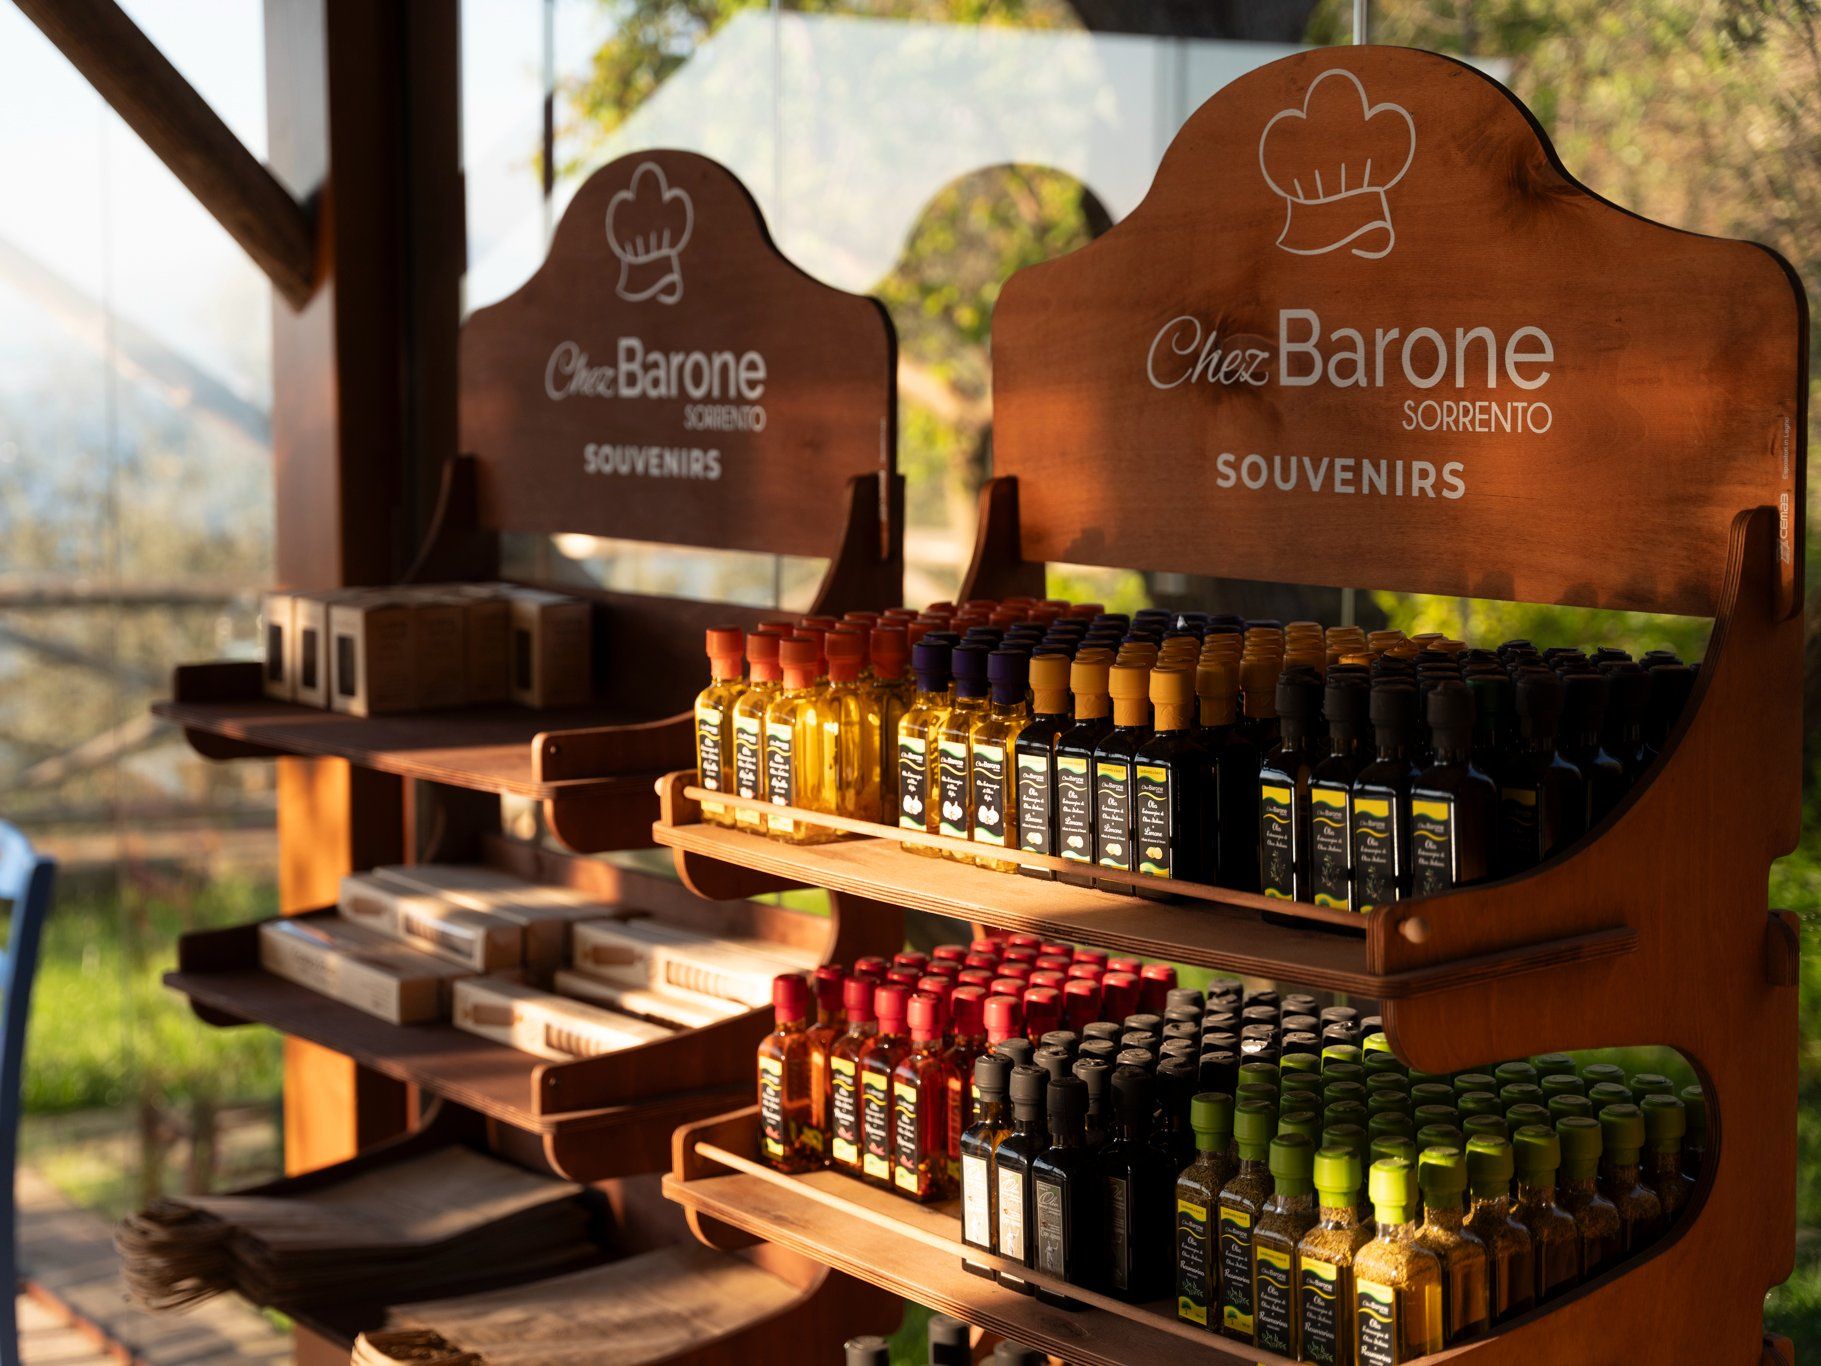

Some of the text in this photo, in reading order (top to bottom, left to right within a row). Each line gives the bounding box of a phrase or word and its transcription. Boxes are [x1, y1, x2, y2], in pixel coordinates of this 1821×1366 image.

[545, 336, 767, 401] Chez Barone
[1146, 309, 1555, 390] Chez Barone
[684, 404, 767, 432] SORRENTO
[1402, 400, 1553, 433] SORRENTO
[584, 443, 722, 480] SOUVENIRS
[1215, 453, 1466, 499] SOUVENIRS
